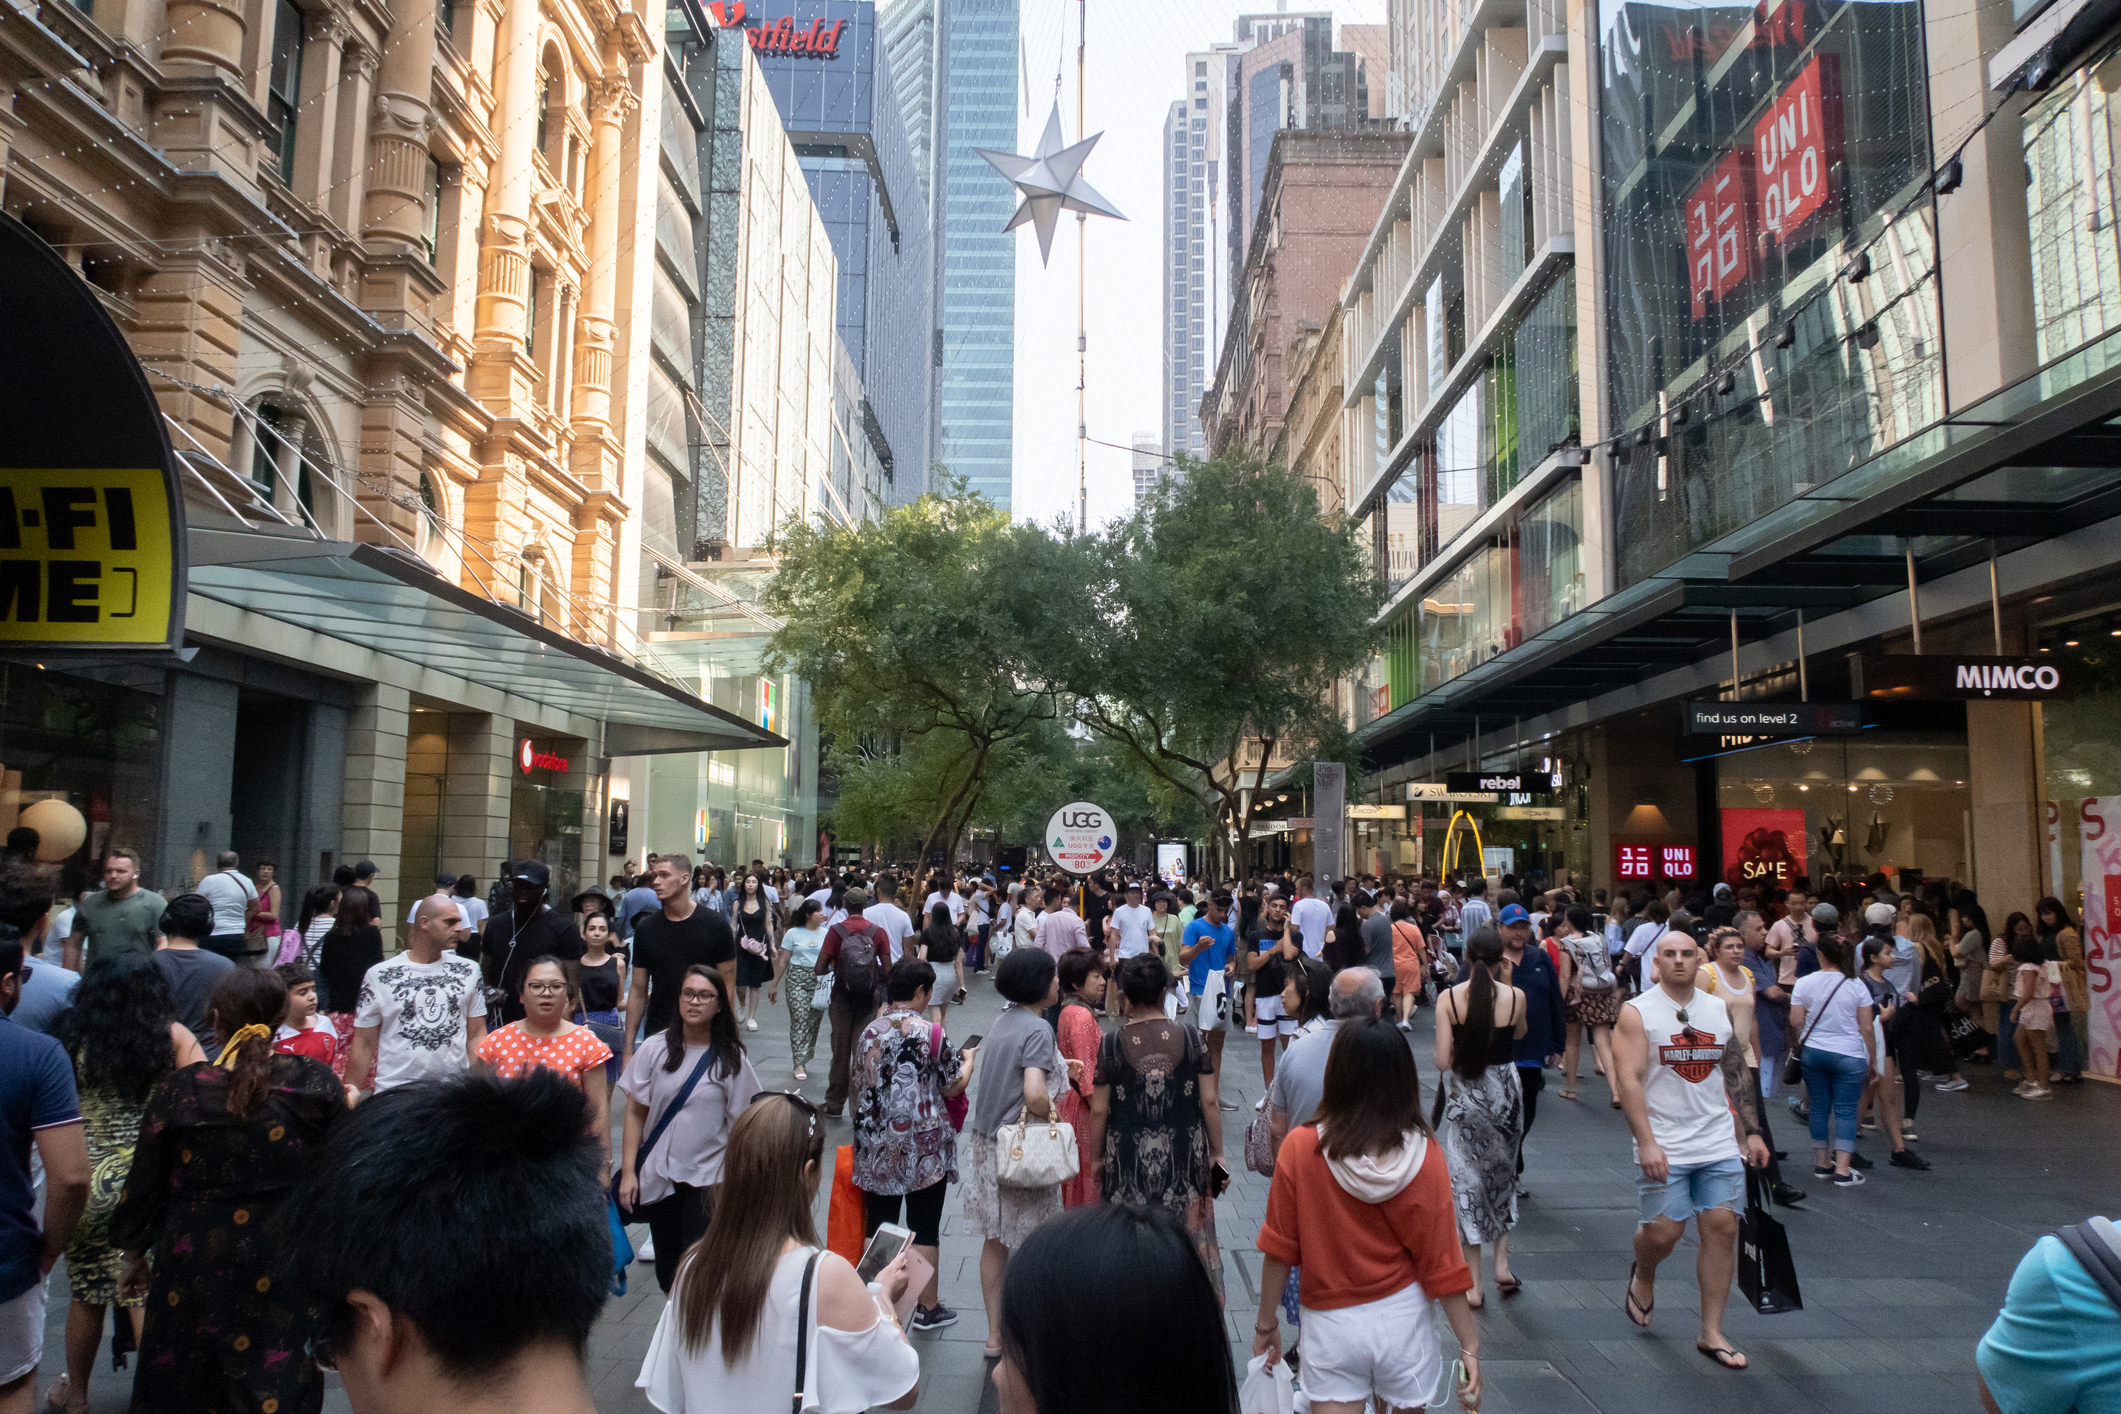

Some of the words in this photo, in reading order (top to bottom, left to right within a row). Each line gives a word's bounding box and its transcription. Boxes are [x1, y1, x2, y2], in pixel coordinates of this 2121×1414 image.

[699, 0, 847, 53] Wstfield
[1761, 90, 1809, 175] UNI
[1765, 145, 1818, 234] QLO
[1956, 665, 2060, 696] MIMCO
[1696, 712, 1720, 724] find
[1723, 715, 1737, 724] us
[1740, 715, 1756, 724] on
[1759, 713, 1786, 724] level
[1789, 713, 1798, 724] 2
[533, 750, 568, 773] vodafone
[1480, 776, 1521, 790] rebel
[1062, 811, 1102, 829] UGG
[1621, 847, 1648, 860] ユニ
[1663, 848, 1690, 861] UNI
[1663, 862, 1692, 878] QLO
[1951, 1016, 1979, 1039] dotti
